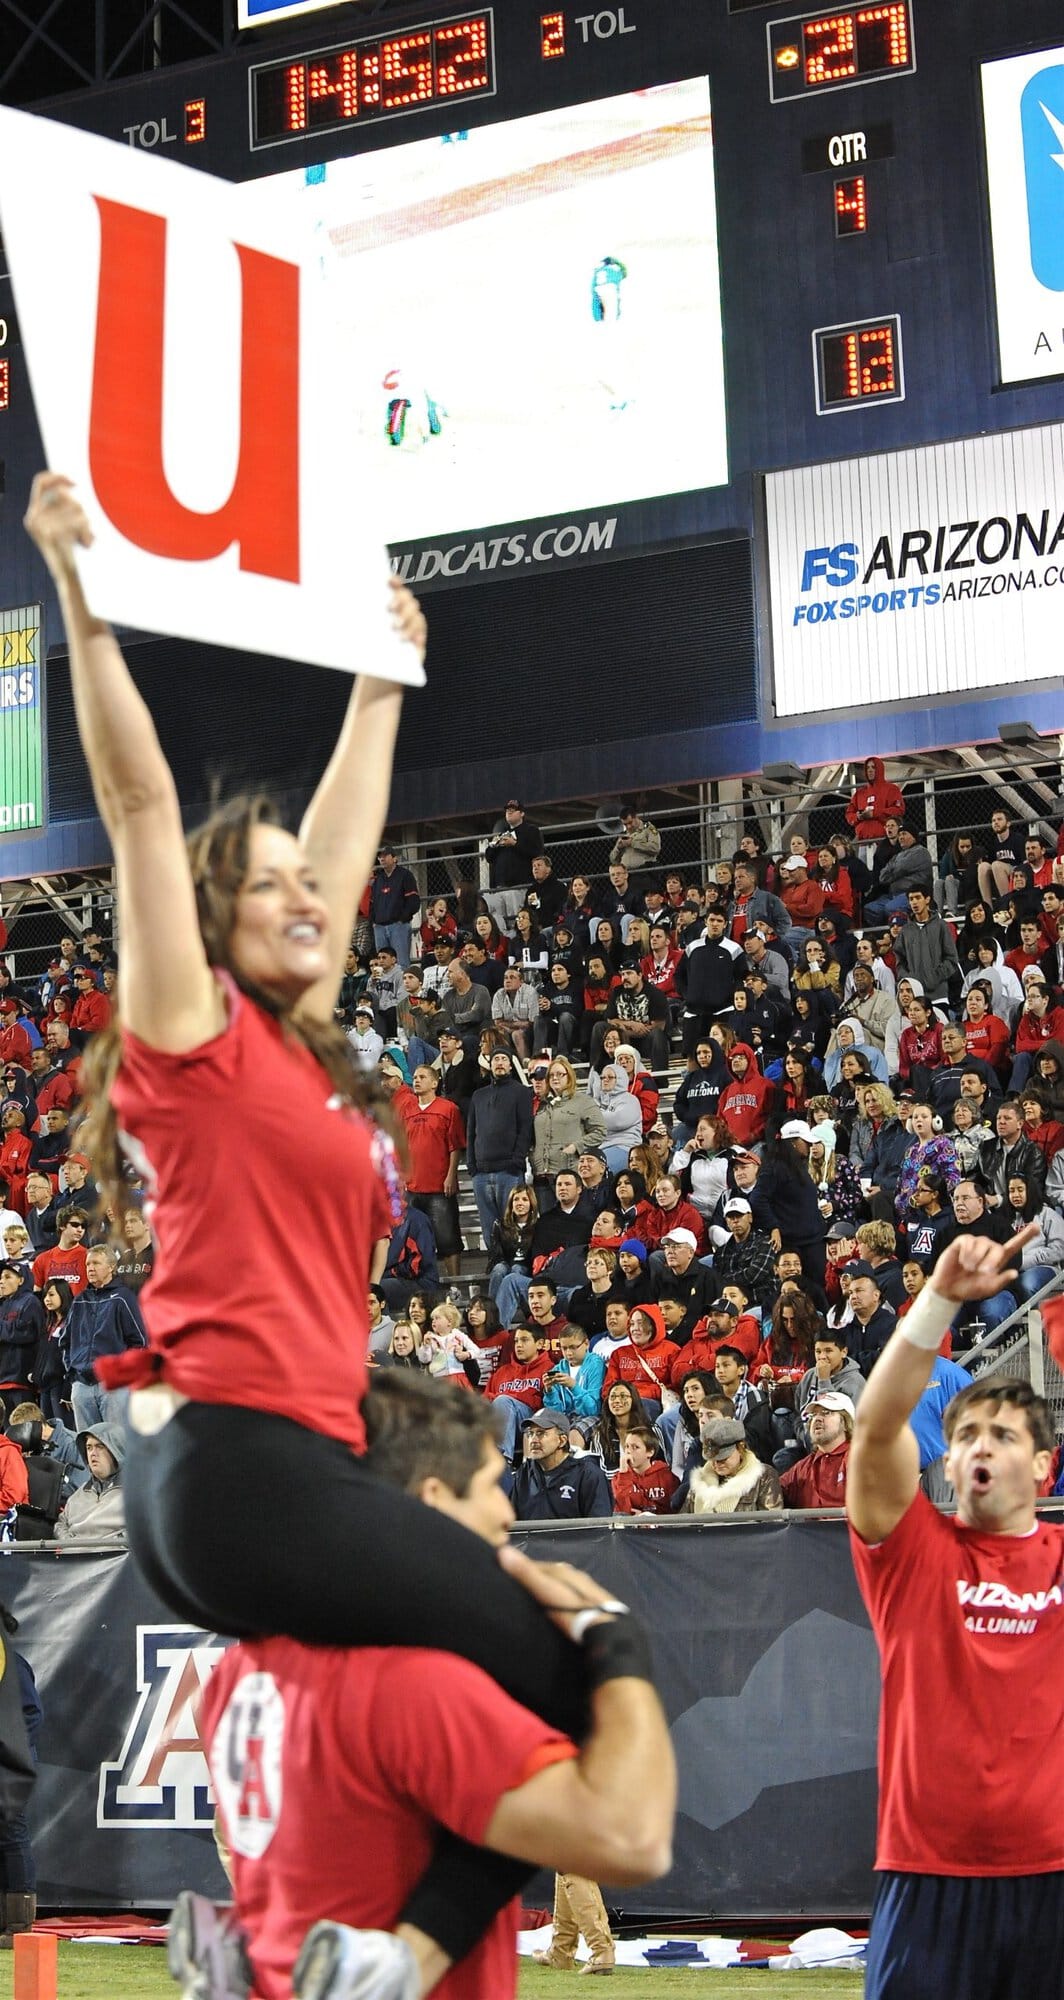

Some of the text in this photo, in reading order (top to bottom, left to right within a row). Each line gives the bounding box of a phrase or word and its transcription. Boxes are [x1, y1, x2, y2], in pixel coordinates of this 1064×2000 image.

[542, 8, 636, 57] 2 TOL
[806, 5, 907, 82] 27
[288, 17, 488, 131] 14:52
[123, 101, 205, 148] TOL 3
[828, 131, 867, 166] QTR
[836, 178, 866, 230] 4
[801, 542, 860, 592] FS
[499, 1379, 541, 1393] ARIZONA
[964, 1615, 1037, 1635] ALUMNI
